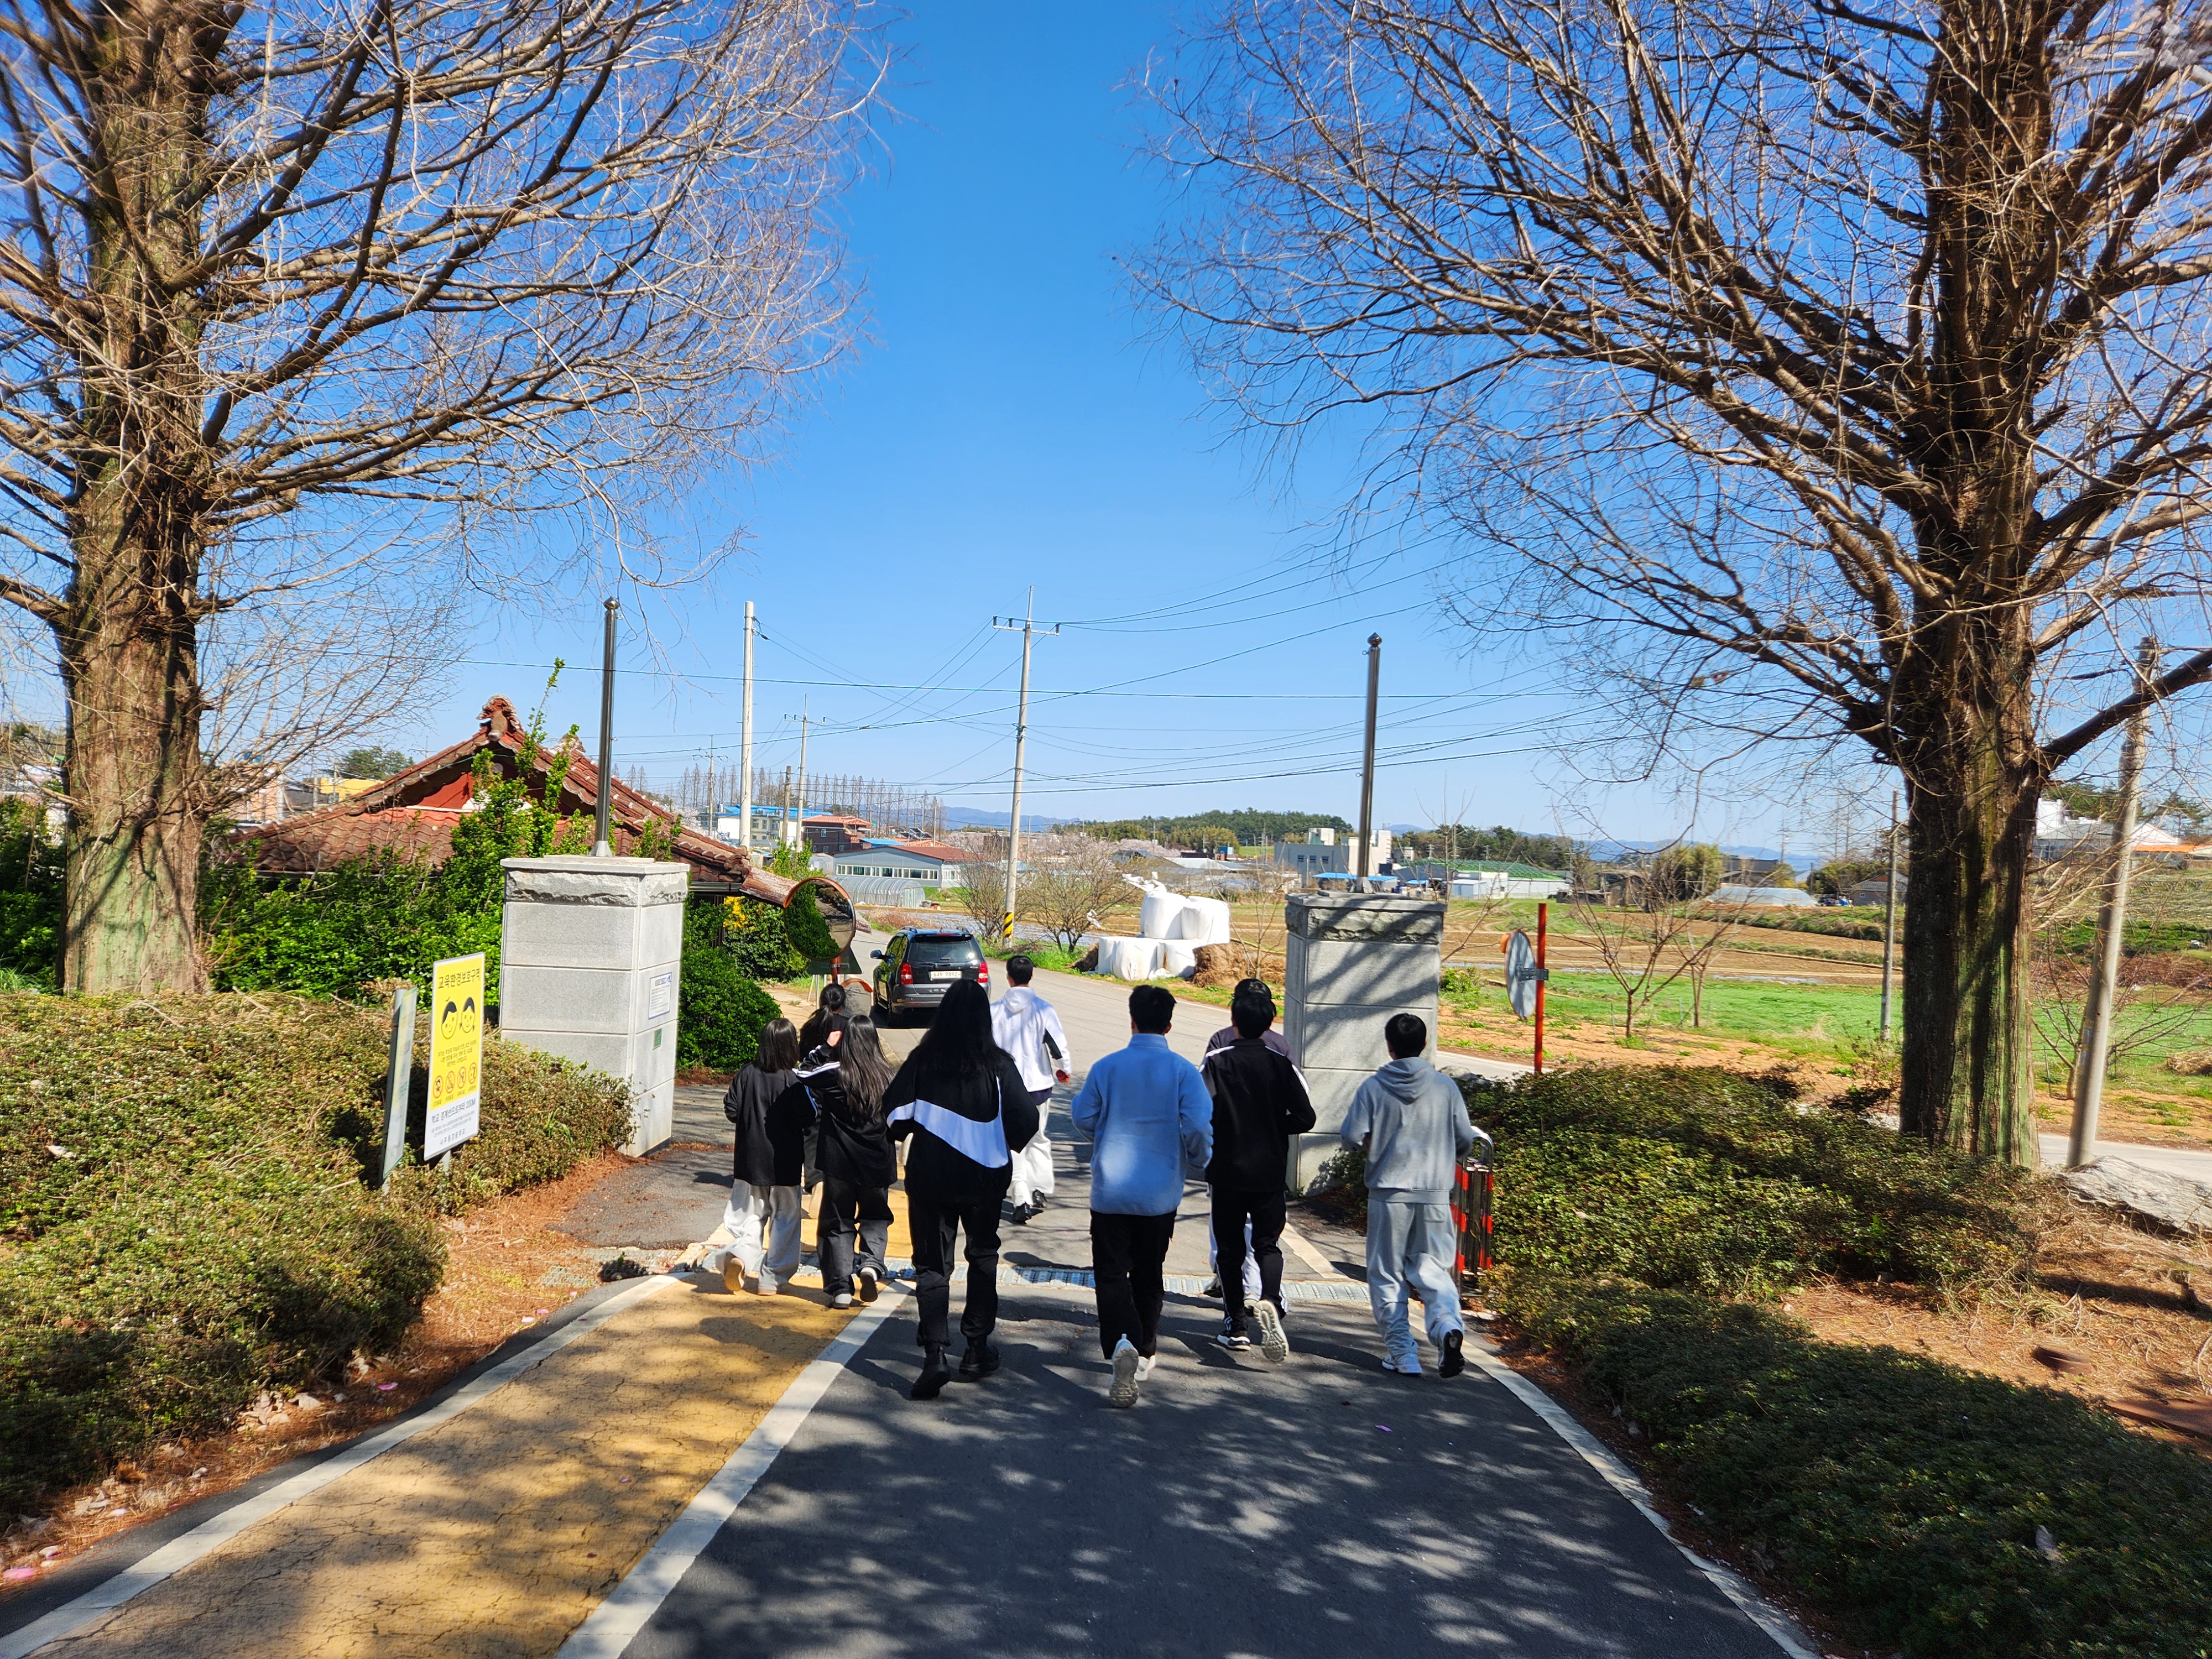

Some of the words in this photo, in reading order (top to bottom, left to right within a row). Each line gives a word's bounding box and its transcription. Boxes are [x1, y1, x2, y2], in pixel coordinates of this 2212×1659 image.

[438, 968, 480, 989] 교육환경보호구역
[431, 1113, 439, 1123] 학교
[441, 1102, 465, 1120] 경계선으로부터
[466, 1098, 476, 1108] 200M
